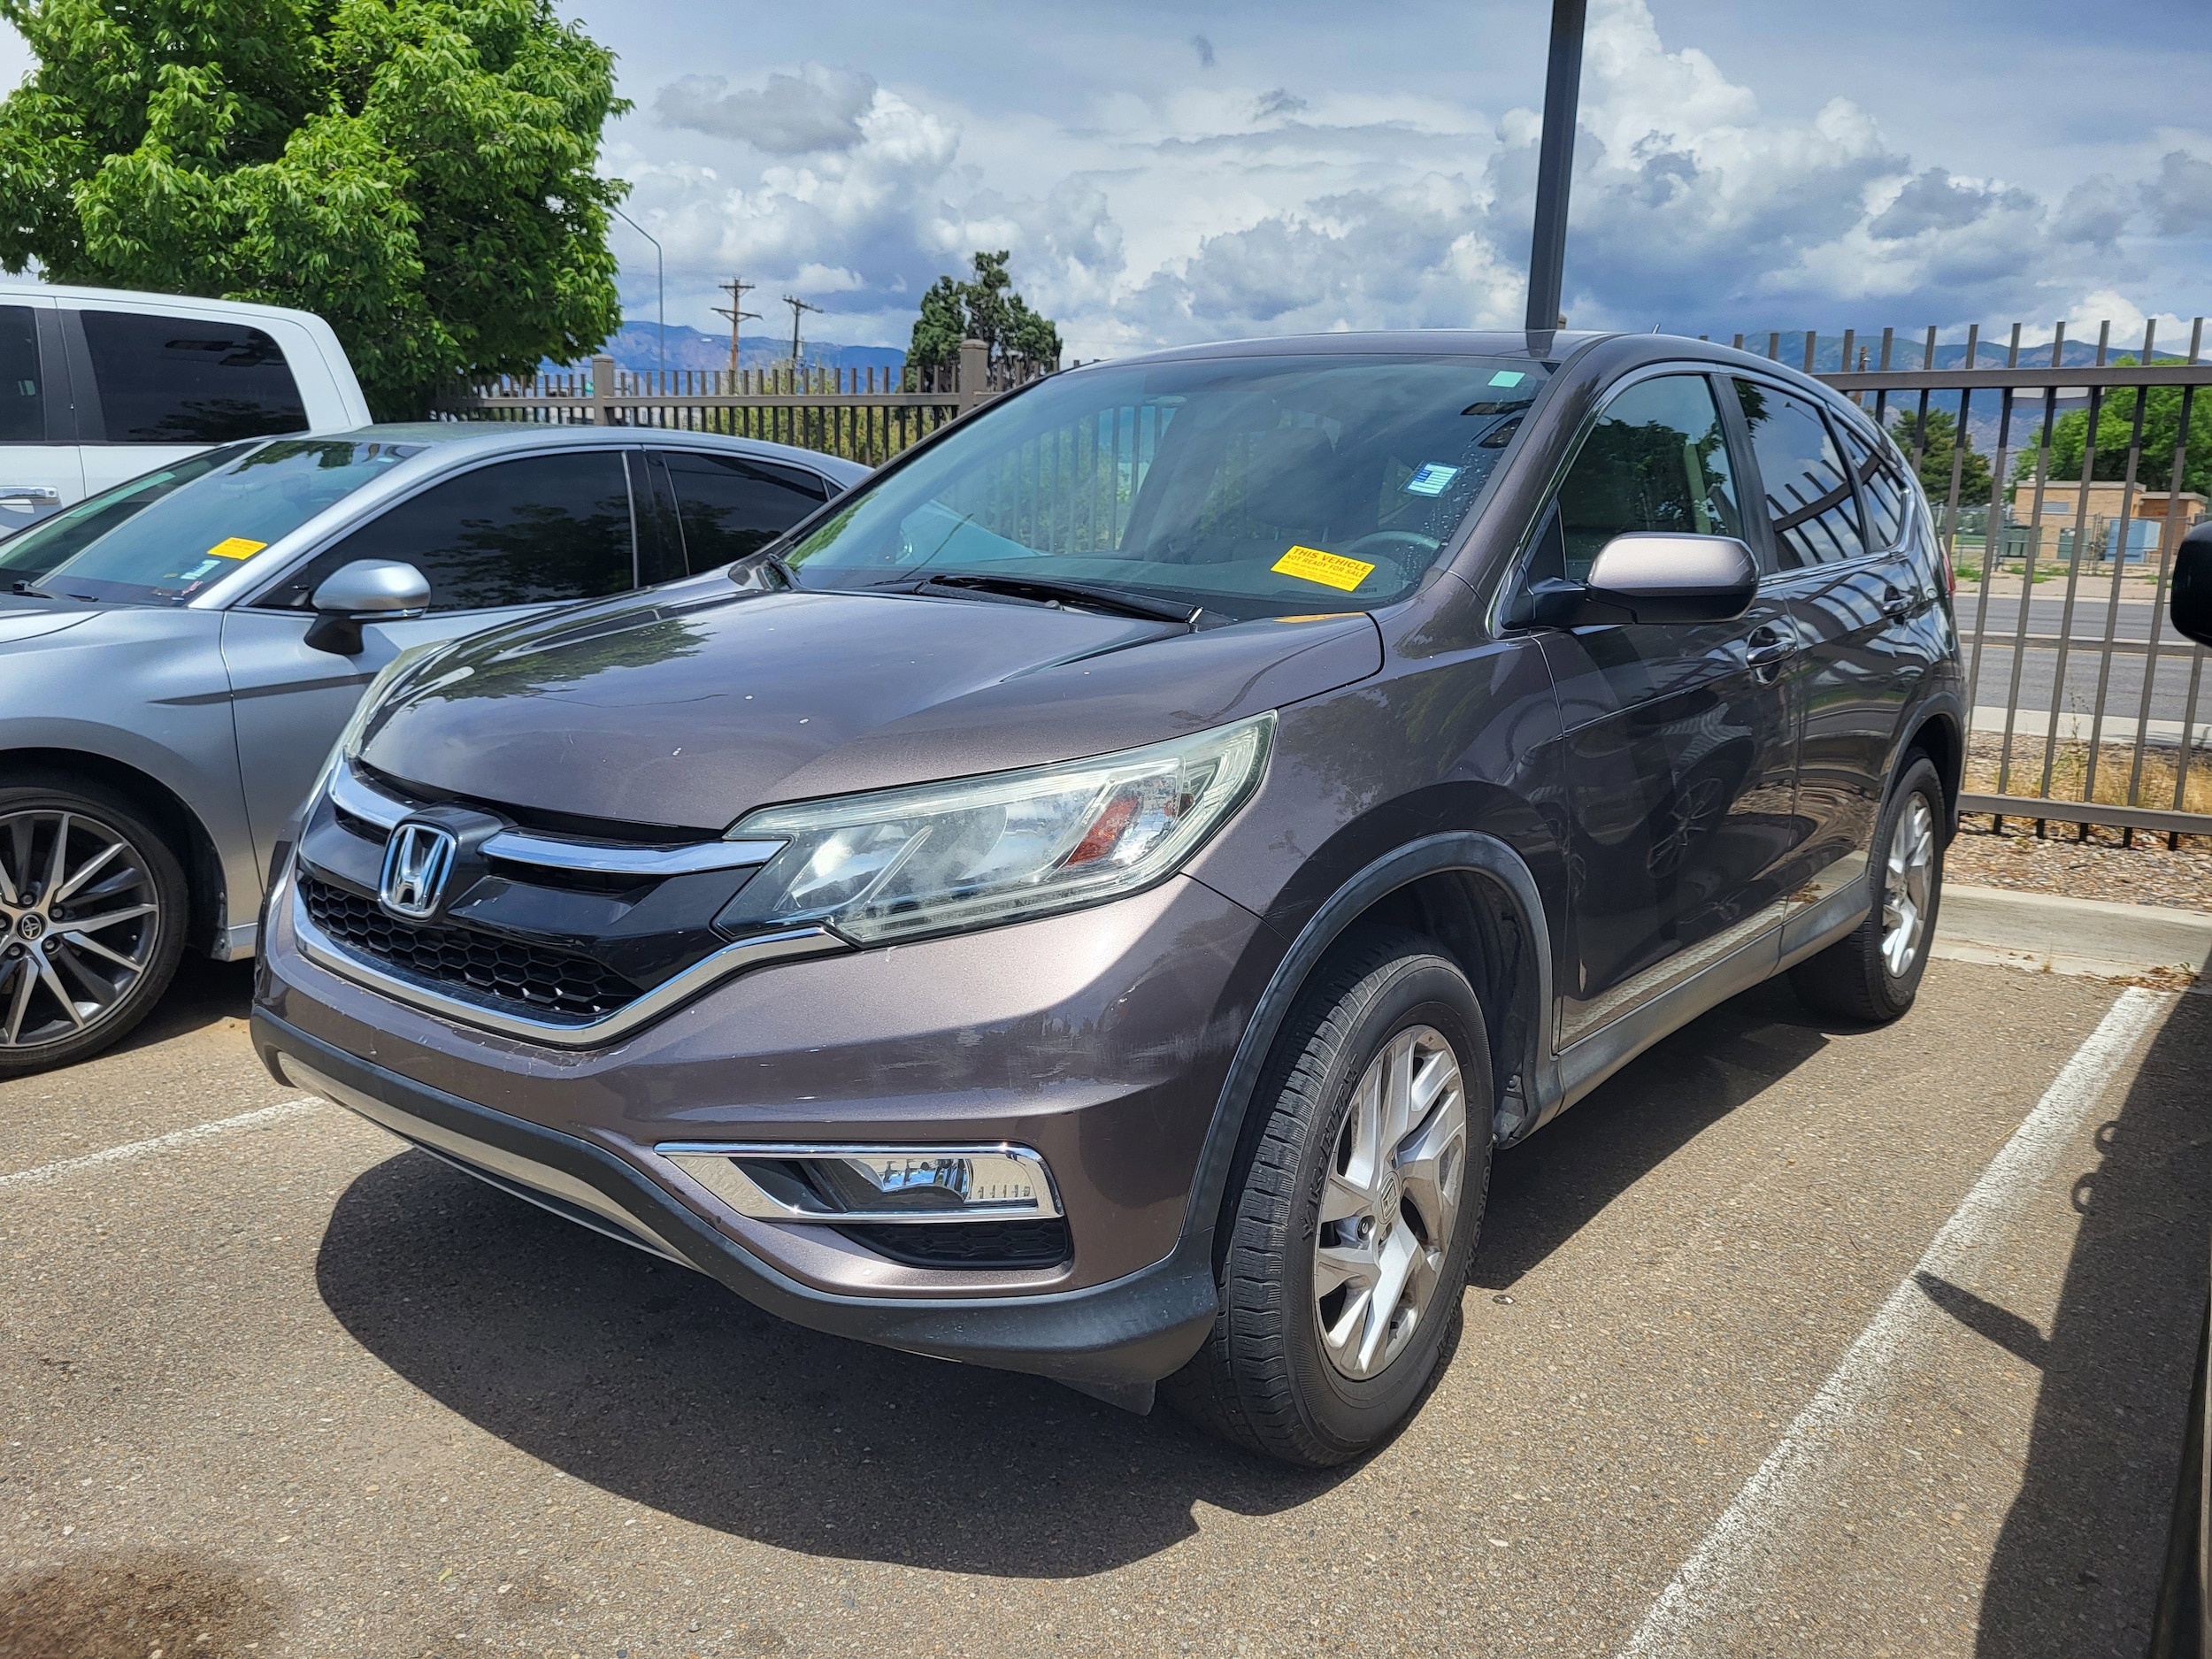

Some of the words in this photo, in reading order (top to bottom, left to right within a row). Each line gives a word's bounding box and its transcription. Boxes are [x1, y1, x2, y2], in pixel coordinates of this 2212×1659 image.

[1293, 548, 1320, 559] THIS
[1321, 555, 1371, 572] VEHICLE
[1302, 557, 1327, 568] READY
[1344, 568, 1366, 579] SALE
